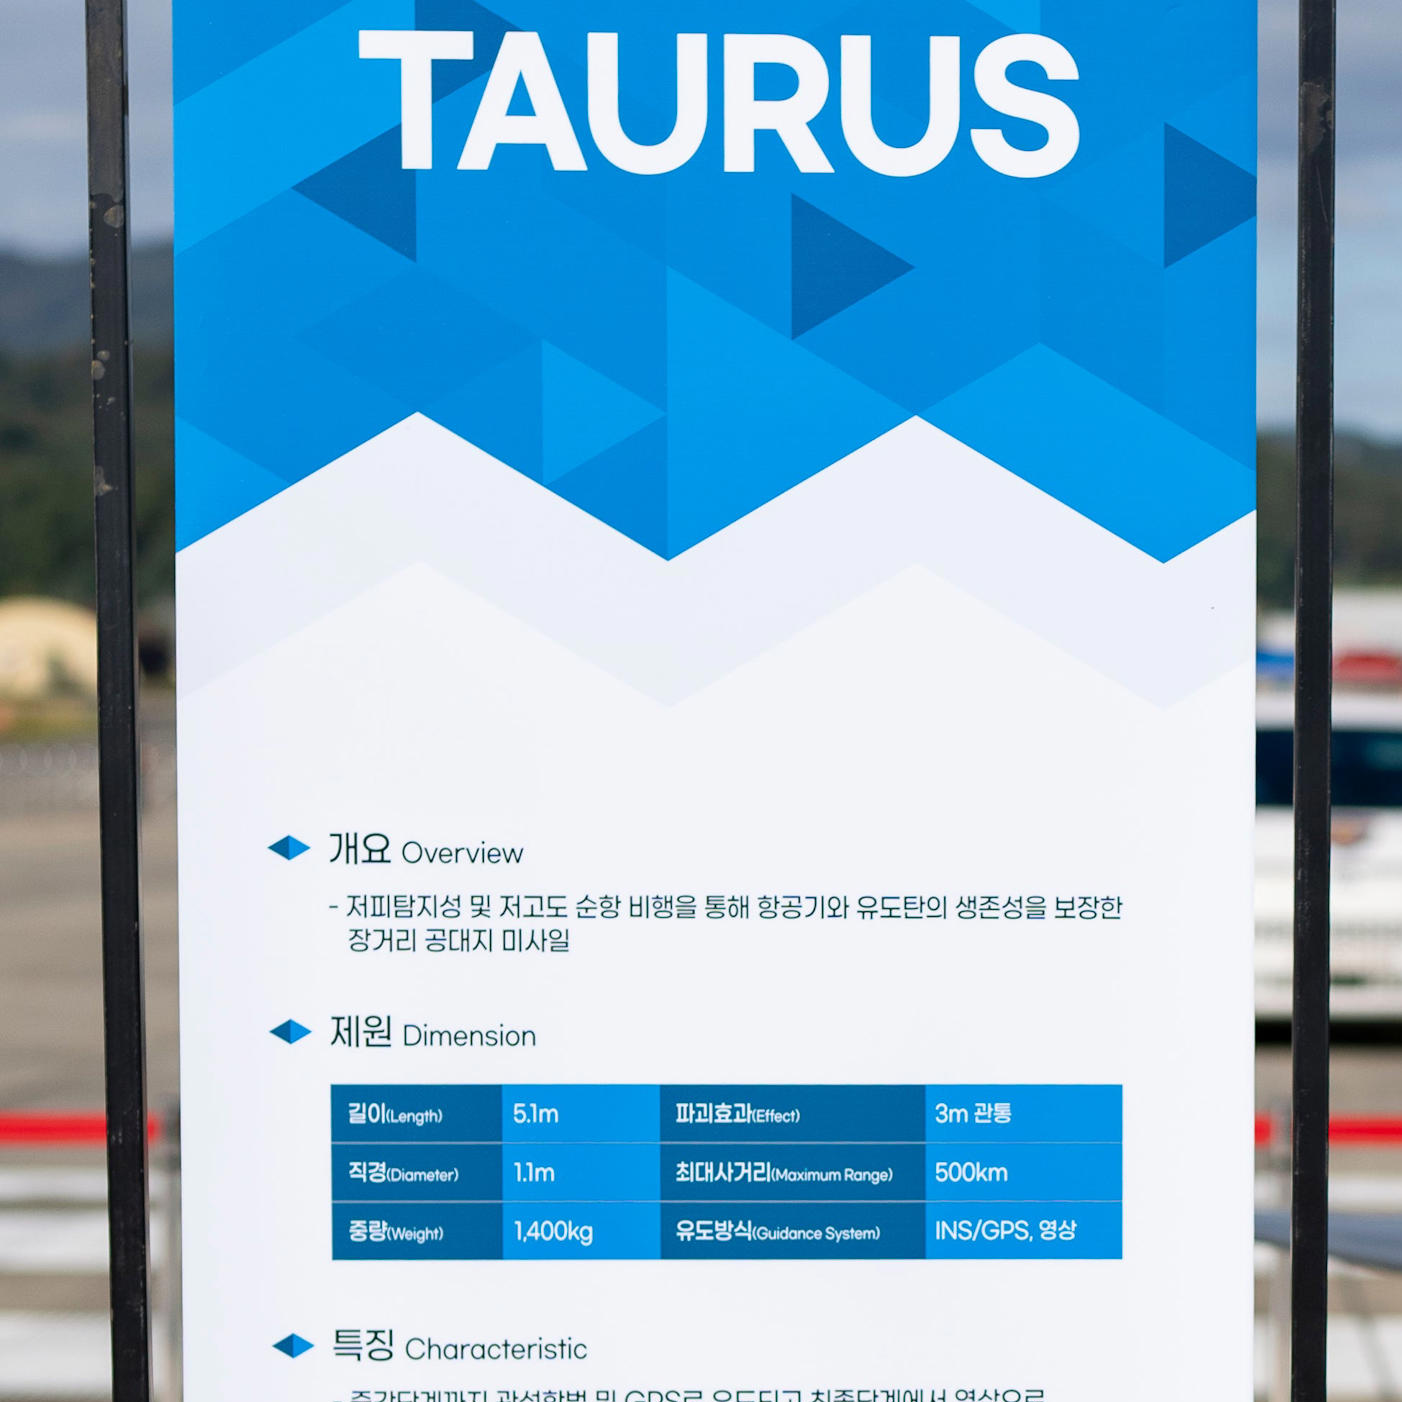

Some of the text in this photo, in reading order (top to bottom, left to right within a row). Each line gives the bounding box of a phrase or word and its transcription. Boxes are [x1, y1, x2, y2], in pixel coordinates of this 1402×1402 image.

[358, 29, 1080, 178] TAURUS
[329, 831, 524, 866] 개요 Overview
[346, 893, 461, 919] 저피탐지성
[470, 894, 491, 919] 및
[499, 894, 569, 919] 저고도
[575, 893, 622, 920] 순항
[629, 894, 697, 920] 비행을
[704, 894, 750, 920] 통해
[757, 894, 850, 920] 항공기와
[856, 895, 947, 921] 유도탄의
[955, 895, 1047, 920] 생존성을
[1054, 895, 1124, 921] 보장한
[348, 927, 570, 953] 장거리 공대지 미사일
[330, 1014, 537, 1049] 제원 Dimension
[513, 1102, 559, 1124] 5.1m
[935, 1102, 1012, 1124] 3m 관통
[513, 1161, 555, 1183] 1.1m
[935, 1161, 1009, 1183] 500km
[514, 1219, 593, 1247] 1,400kg
[935, 1219, 1078, 1242] INS/GPS, 영상
[332, 1328, 588, 1363] 특징 Characteristic
